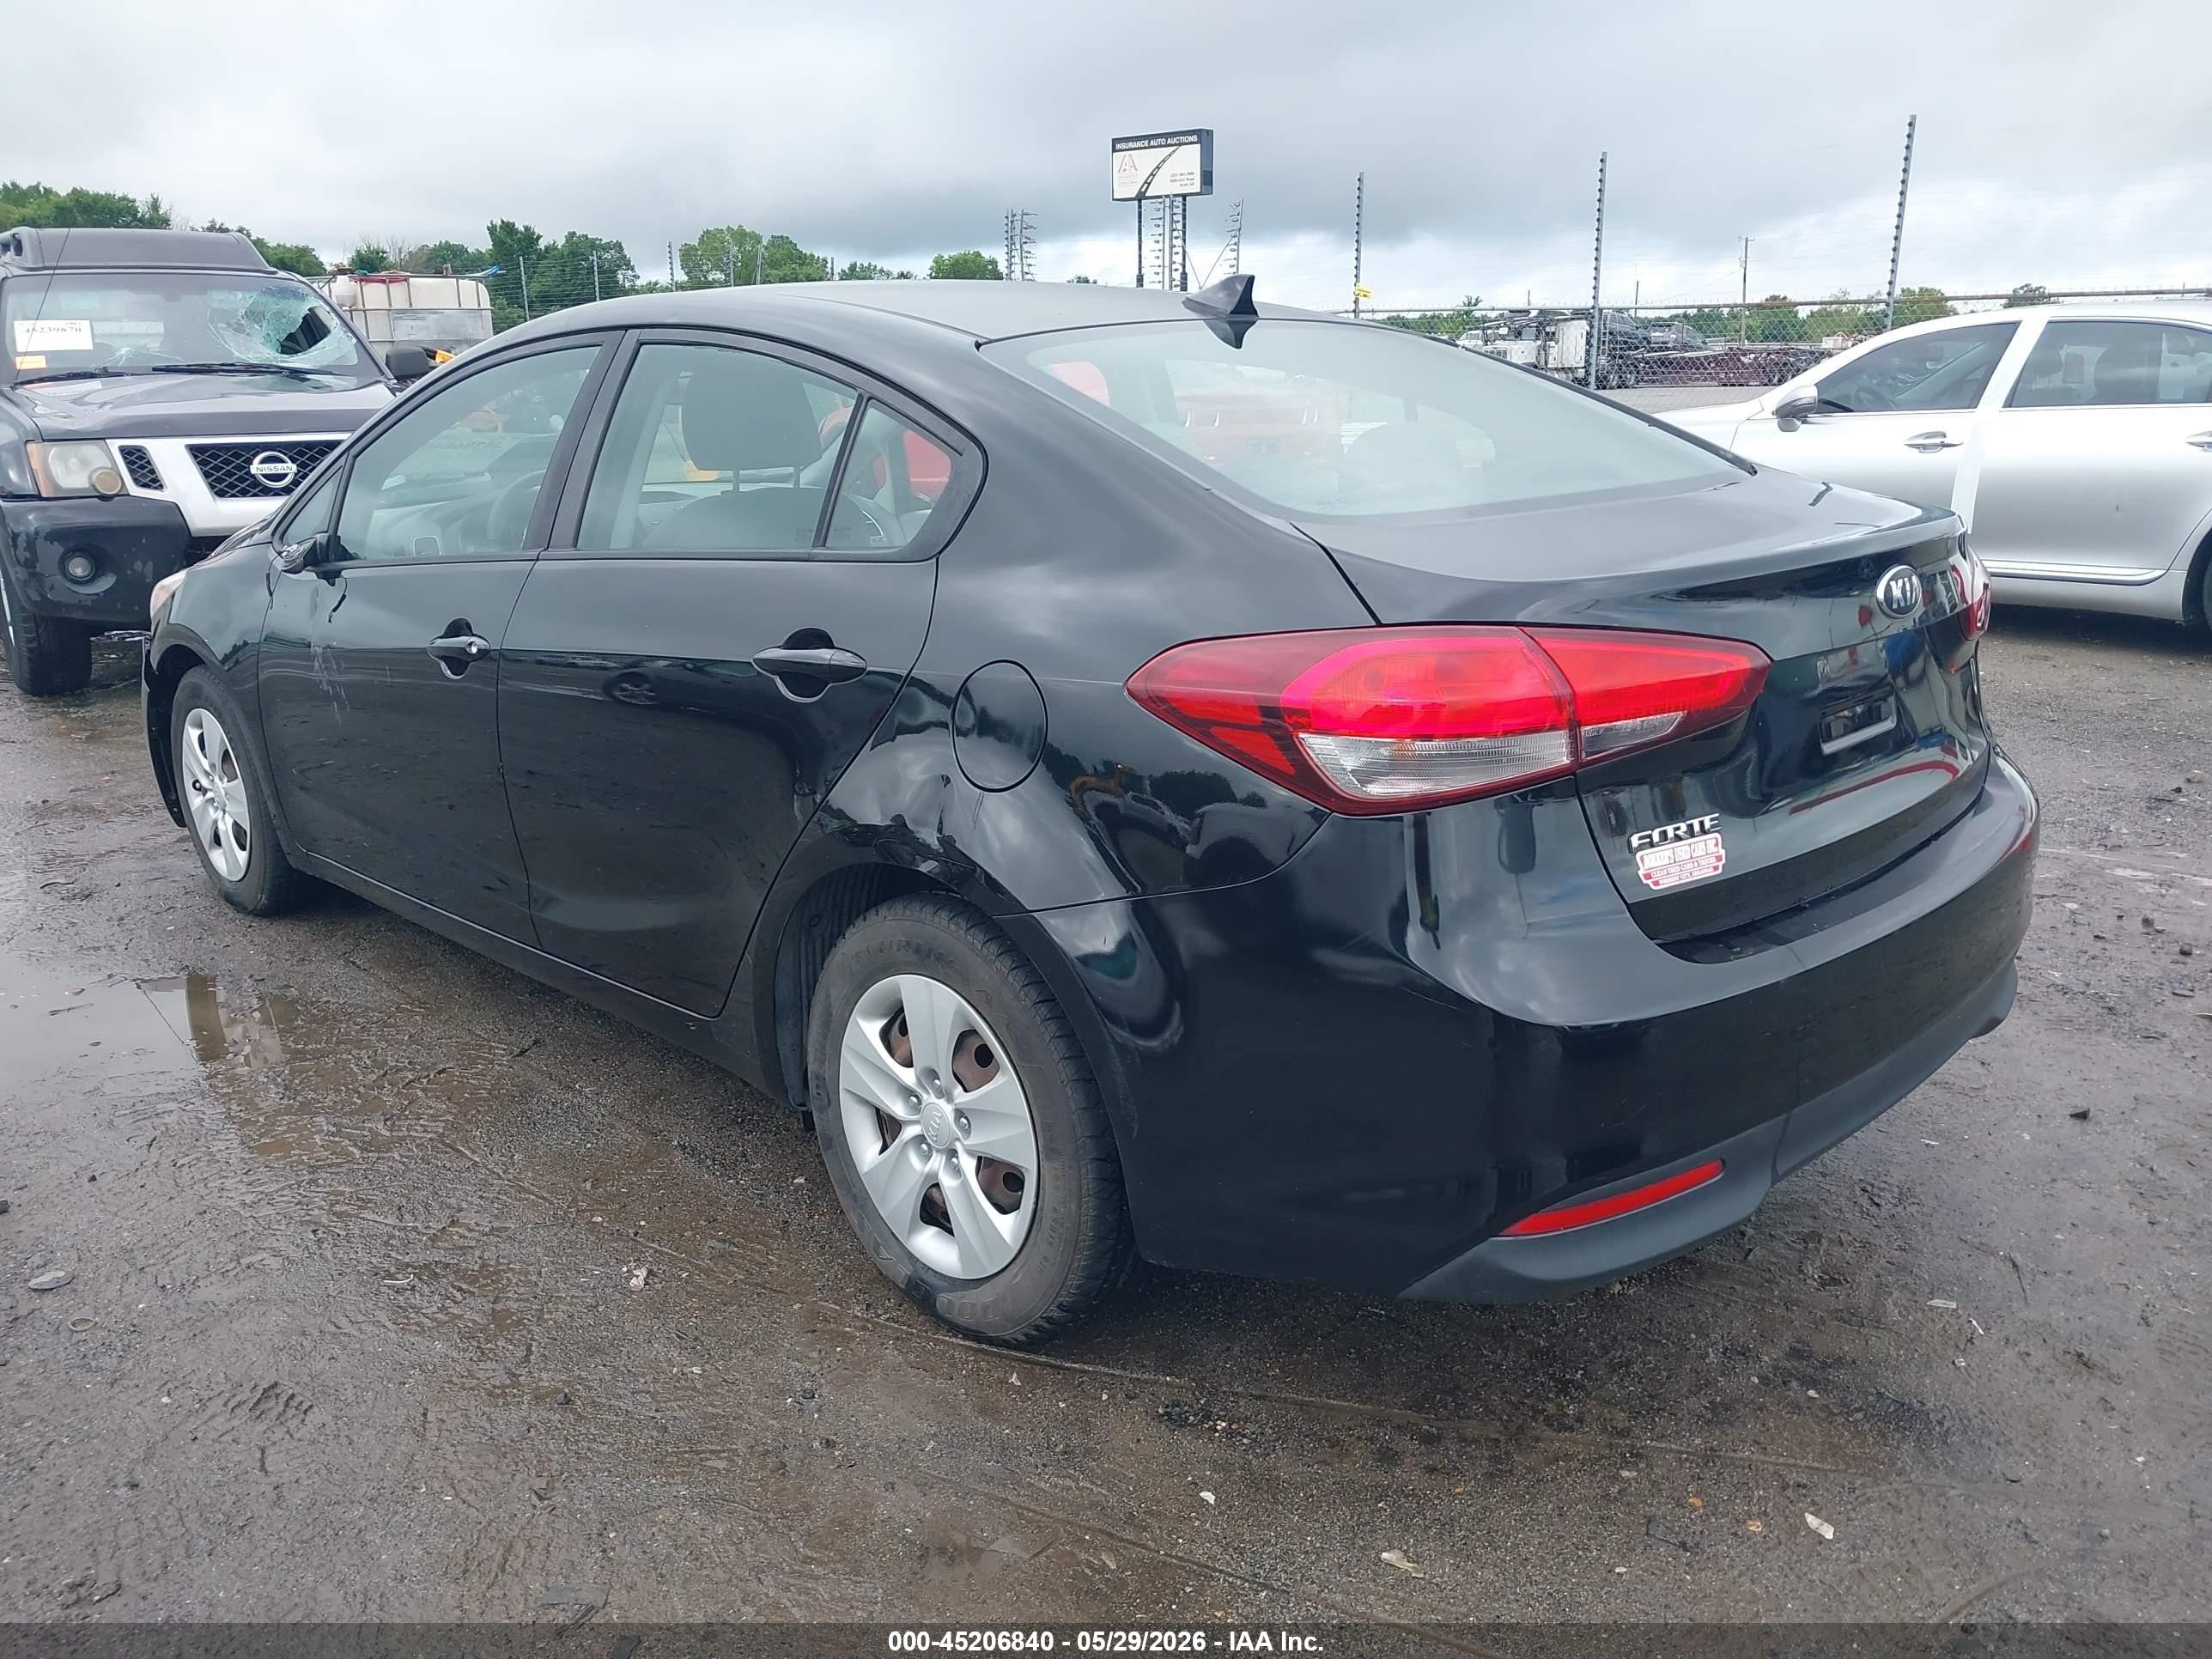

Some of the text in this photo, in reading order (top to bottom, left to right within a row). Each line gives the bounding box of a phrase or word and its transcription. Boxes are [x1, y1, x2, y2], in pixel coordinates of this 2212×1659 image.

[1115, 135, 1198, 150] INSURANCE AUTO AUCTIONS
[1889, 575, 1923, 609] KIA
[1630, 813, 1722, 851] FORTE
[928, 1111, 943, 1142] KIA
